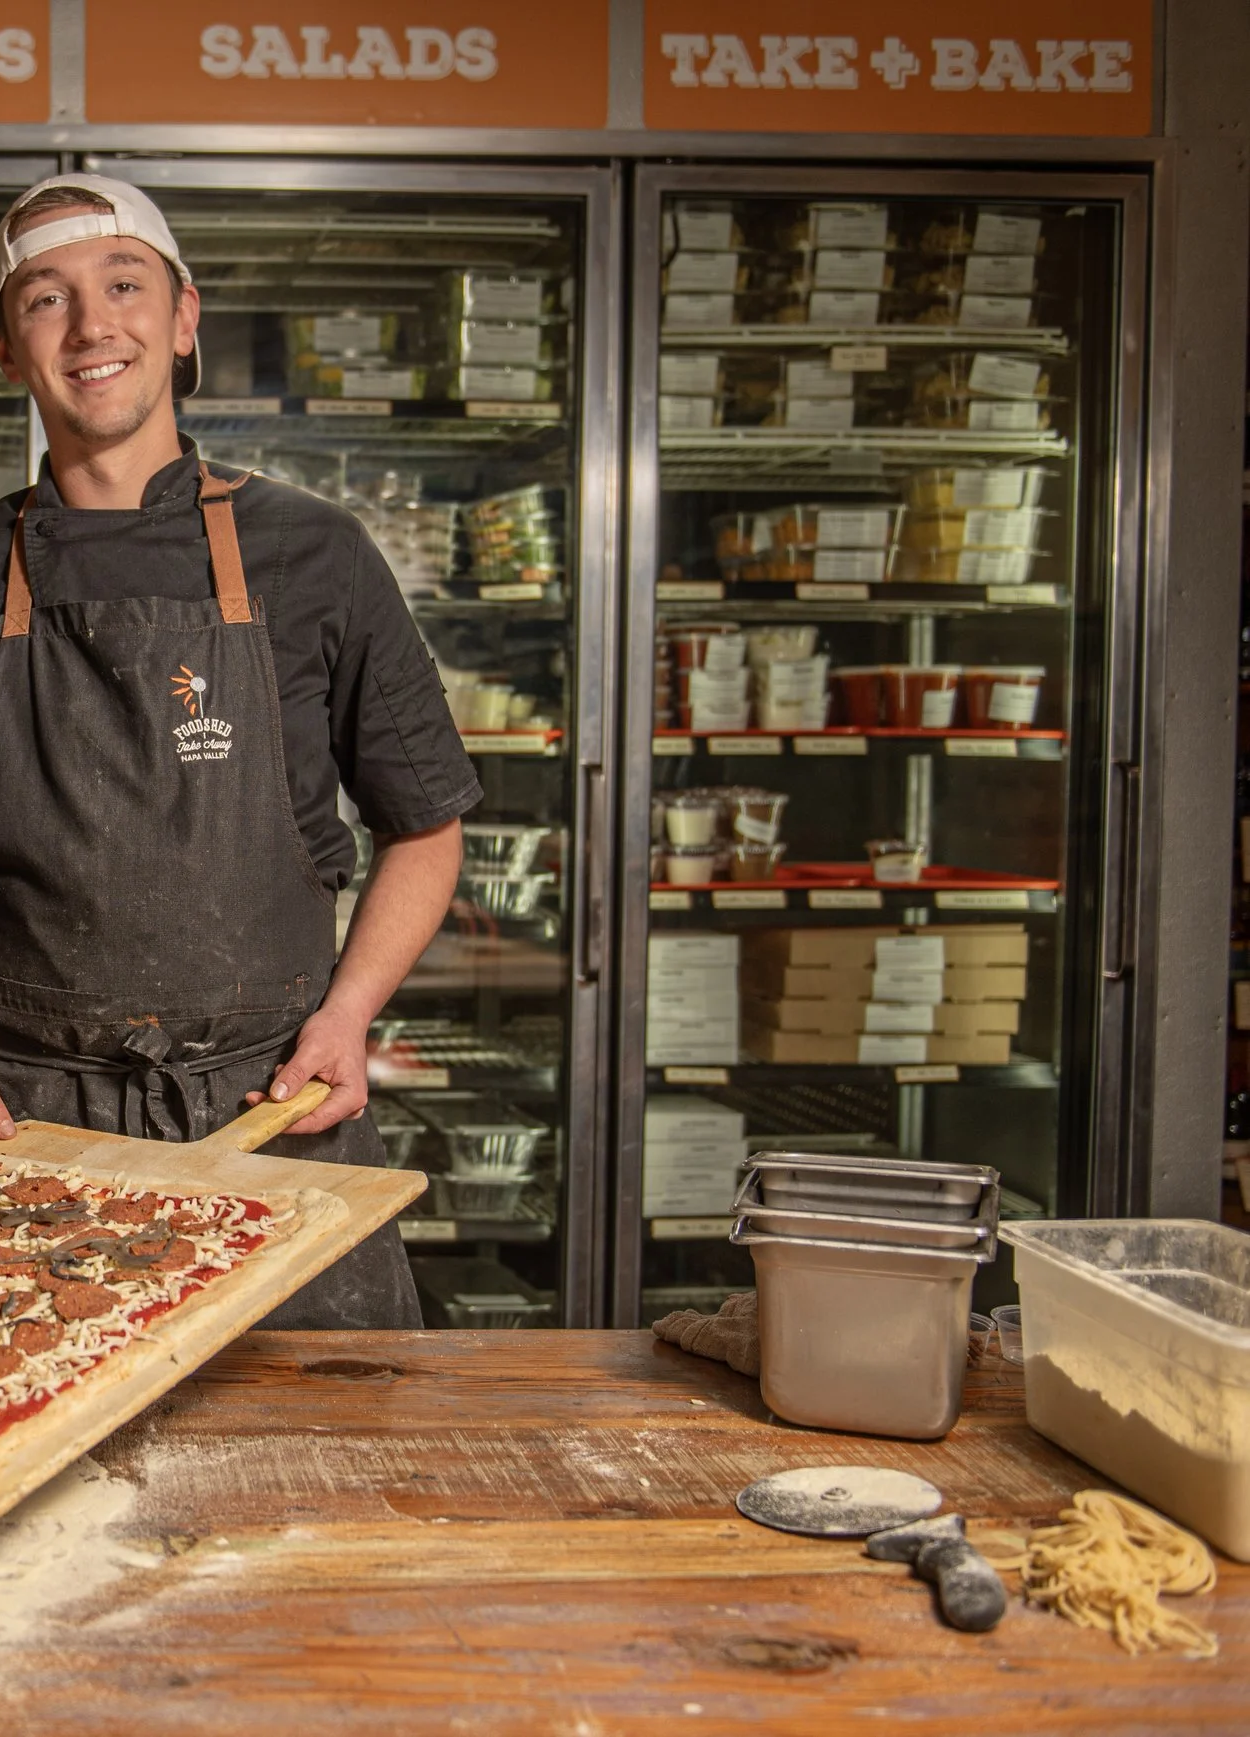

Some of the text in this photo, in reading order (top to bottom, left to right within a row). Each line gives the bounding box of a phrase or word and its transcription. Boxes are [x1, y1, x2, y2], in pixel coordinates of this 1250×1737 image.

[200, 23, 499, 82] SALADS
[661, 33, 858, 89] TAKE
[931, 38, 1132, 93] BAKE
[172, 717, 233, 741] FOODSHED
[176, 738, 232, 753] Take Away
[181, 752, 229, 762] NAPA VALLEY
